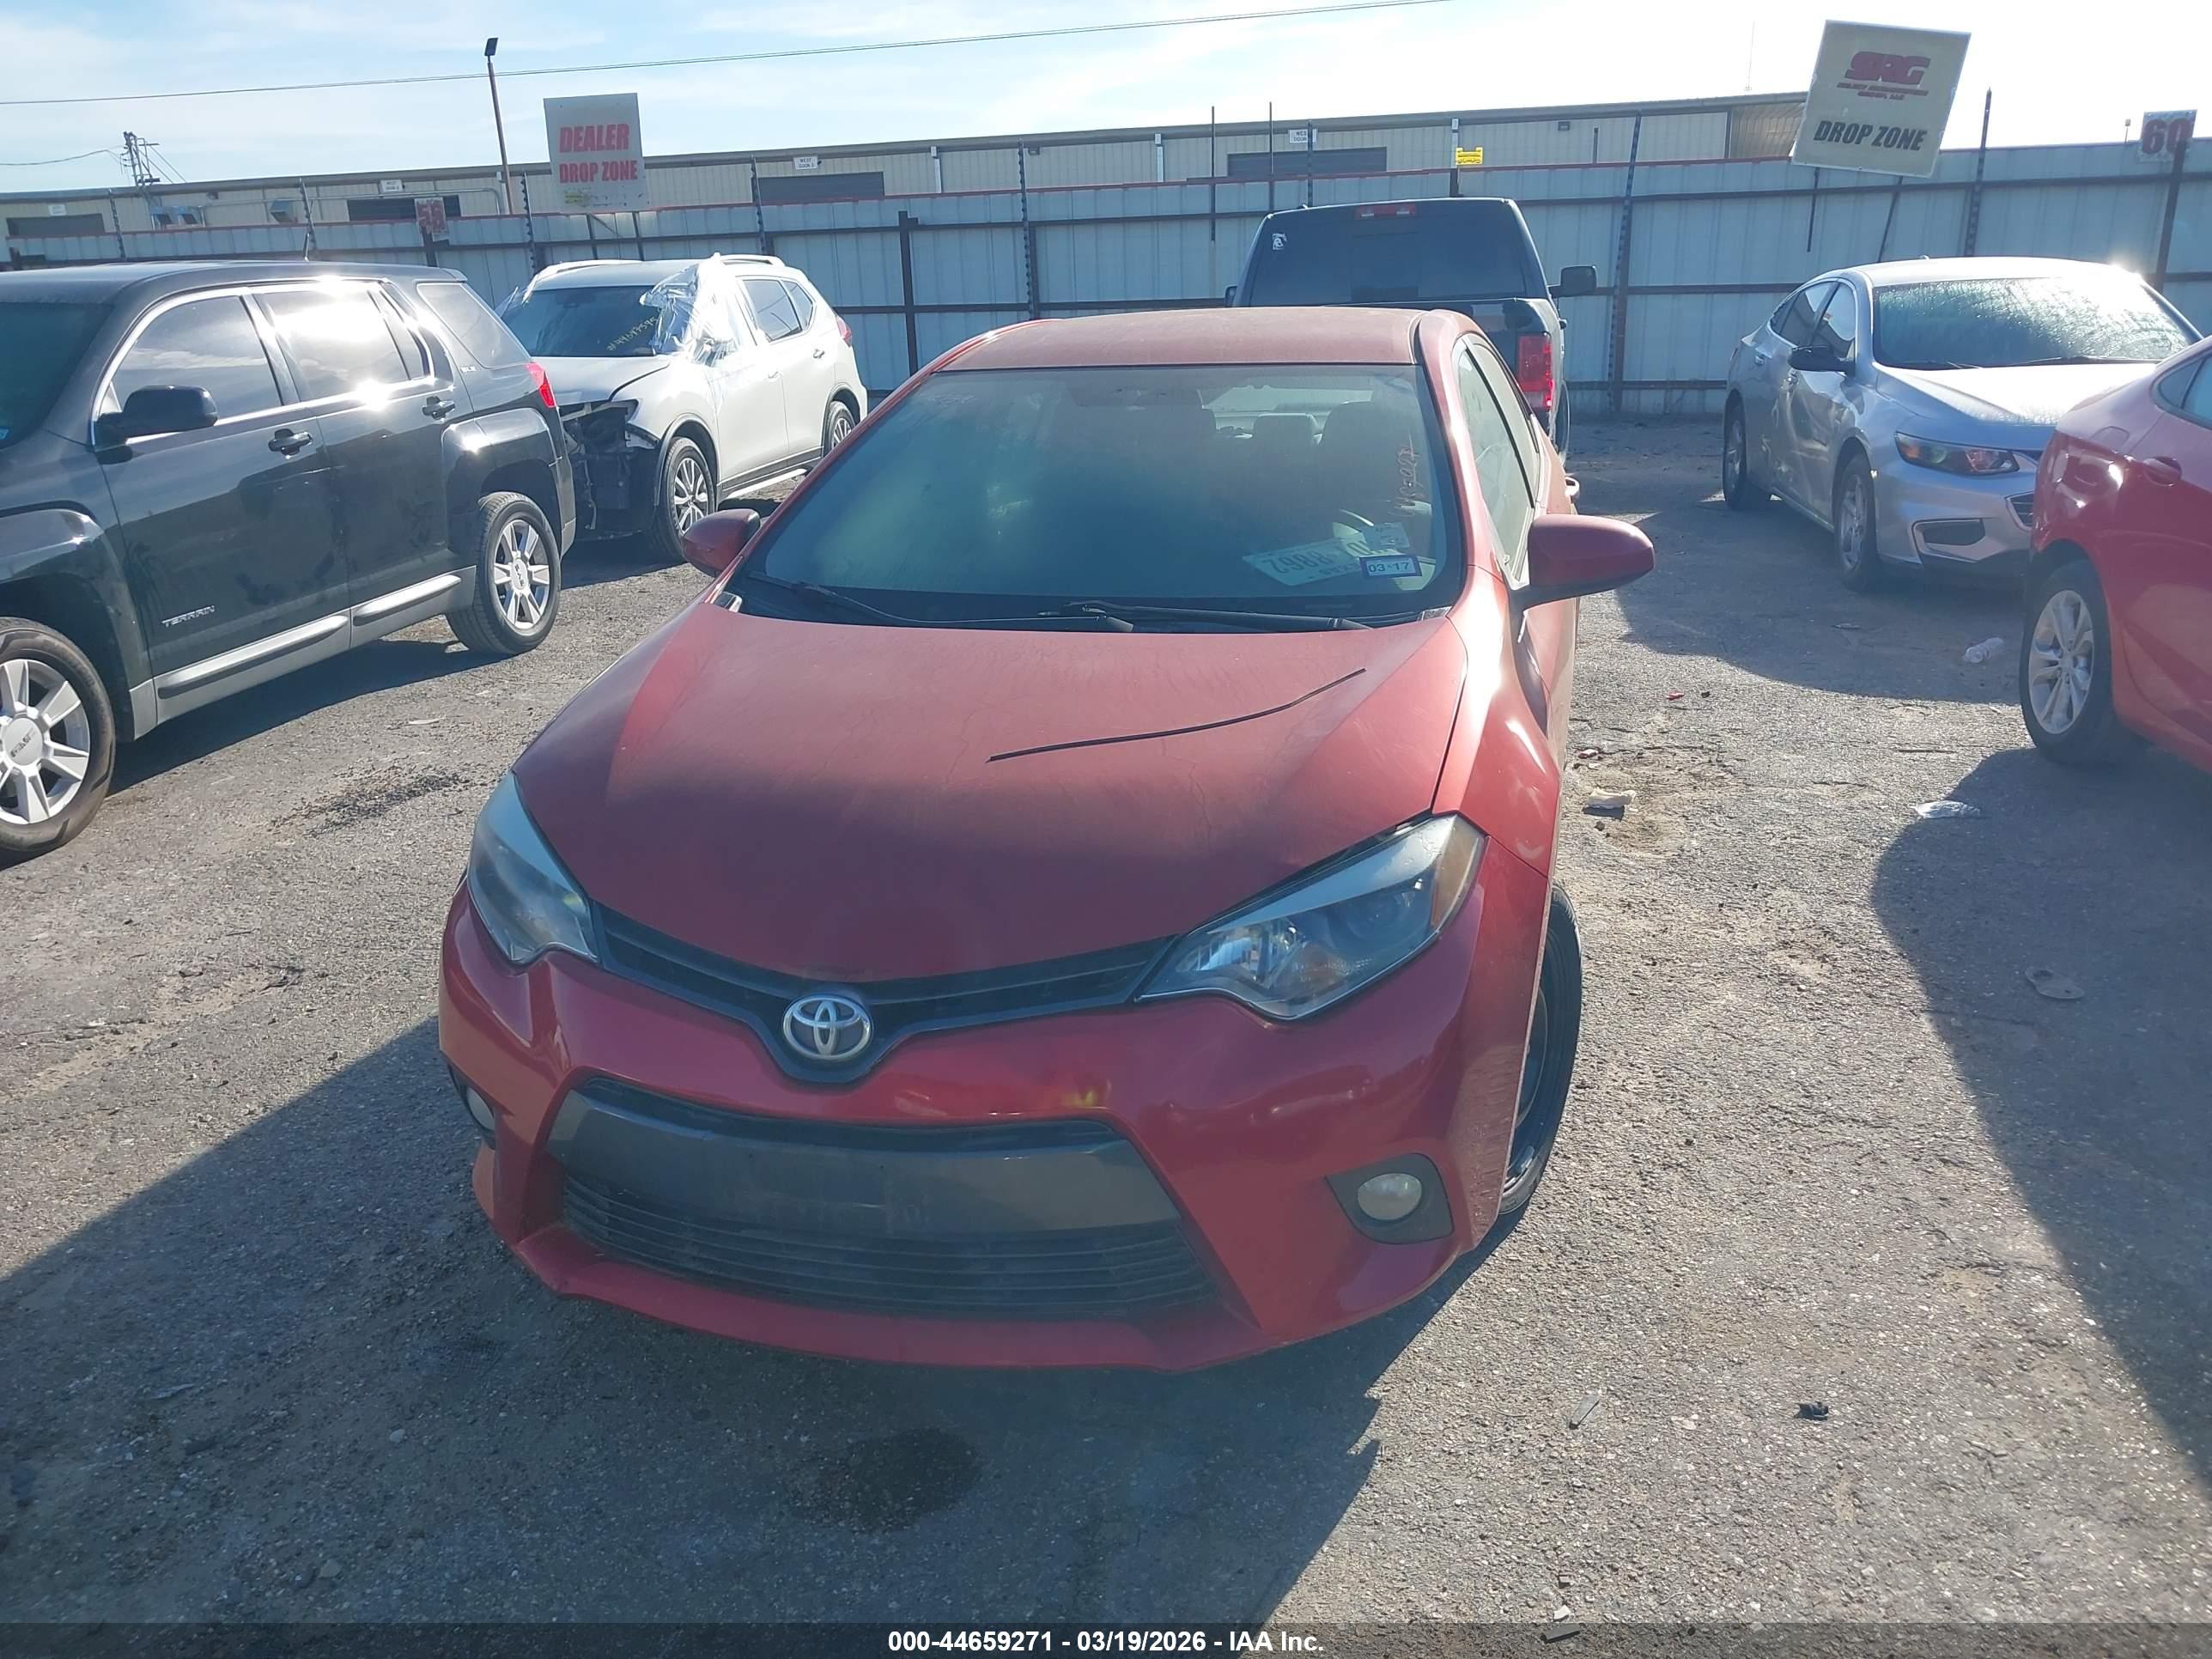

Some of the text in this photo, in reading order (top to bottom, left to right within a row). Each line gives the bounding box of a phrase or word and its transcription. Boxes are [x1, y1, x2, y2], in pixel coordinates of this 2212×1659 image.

[1844, 51, 1931, 86] SRG
[558, 123, 629, 153] DEALER
[1814, 120, 1928, 151] DROP ZONE
[559, 160, 638, 184] DROP ZONE
[161, 605, 216, 628] TERRAIN
